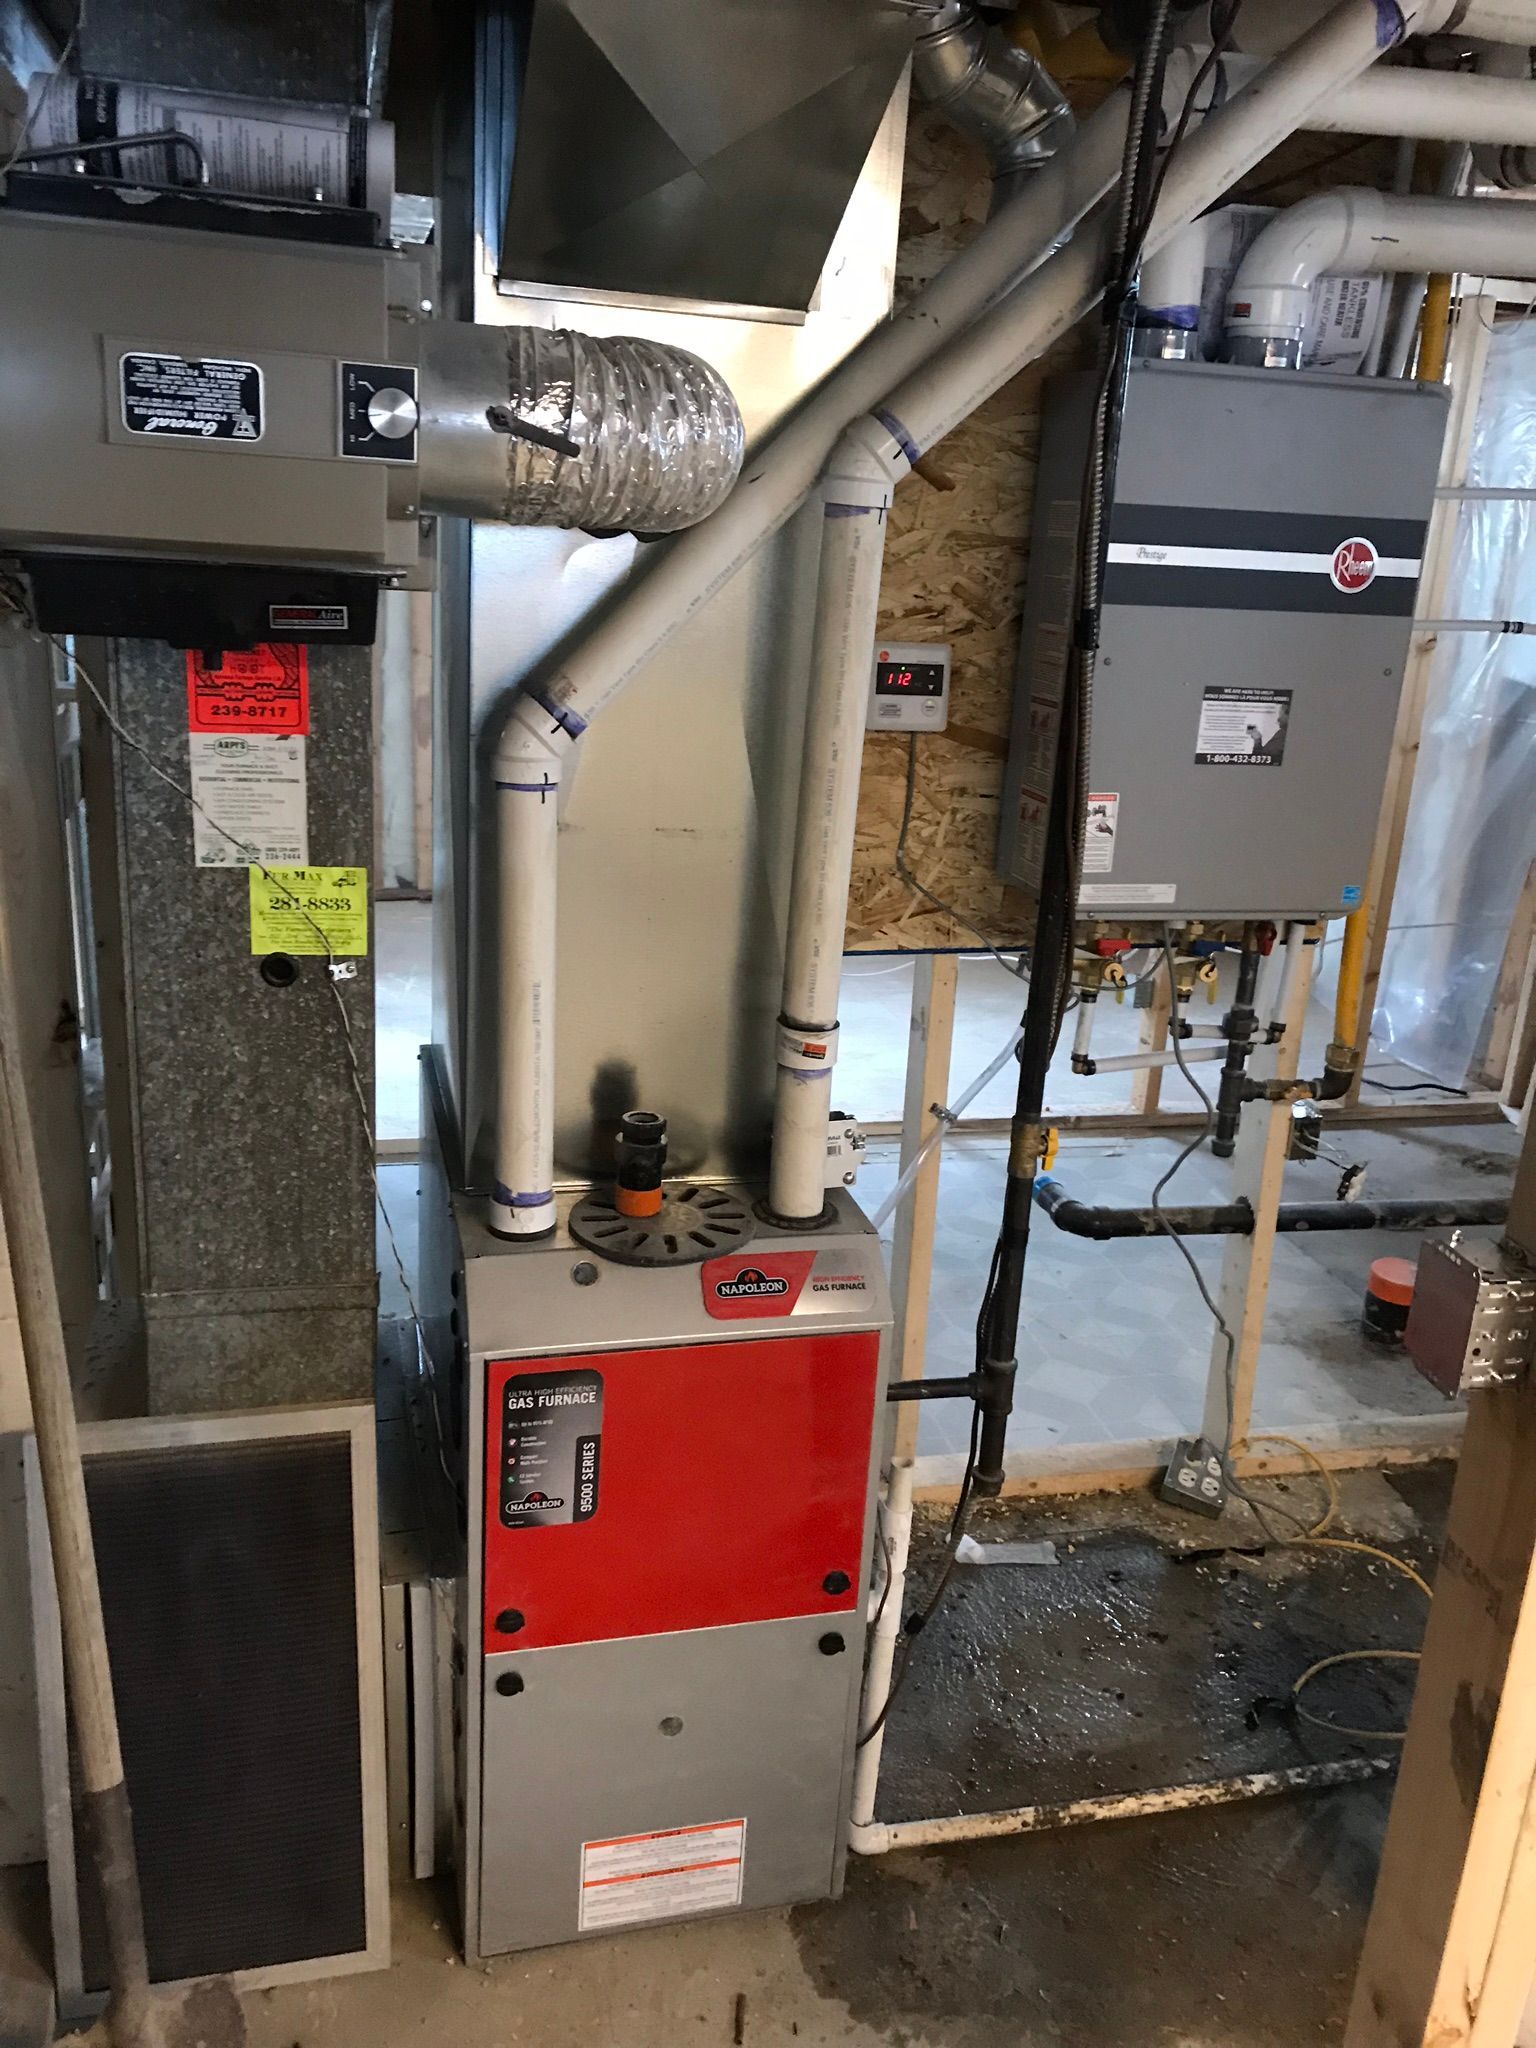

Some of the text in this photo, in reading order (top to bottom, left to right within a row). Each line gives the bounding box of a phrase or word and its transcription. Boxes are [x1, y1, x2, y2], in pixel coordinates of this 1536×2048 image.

[1335, 303, 1346, 326] HEATER
[1342, 282, 1359, 339] TANKLESS
[204, 370, 247, 381] GENERAL
[133, 407, 228, 421] POWER HUMIDIFIER
[143, 417, 218, 436] General
[1336, 543, 1374, 582] Rheem
[887, 672, 912, 687] 112
[210, 704, 287, 718] 239-8717
[1206, 754, 1272, 764] 1-800-432-8373
[294, 870, 322, 881] MAX
[720, 1282, 784, 1295] NAPOLEON
[812, 1283, 866, 1292] GAS FURNACE
[509, 1385, 597, 1398] ULTRA HIGH EFFICIENCY
[508, 1392, 596, 1410] GAS FURNACE
[580, 1442, 595, 1512] 9500 SERIES
[510, 1499, 561, 1511] NAPOLEON
